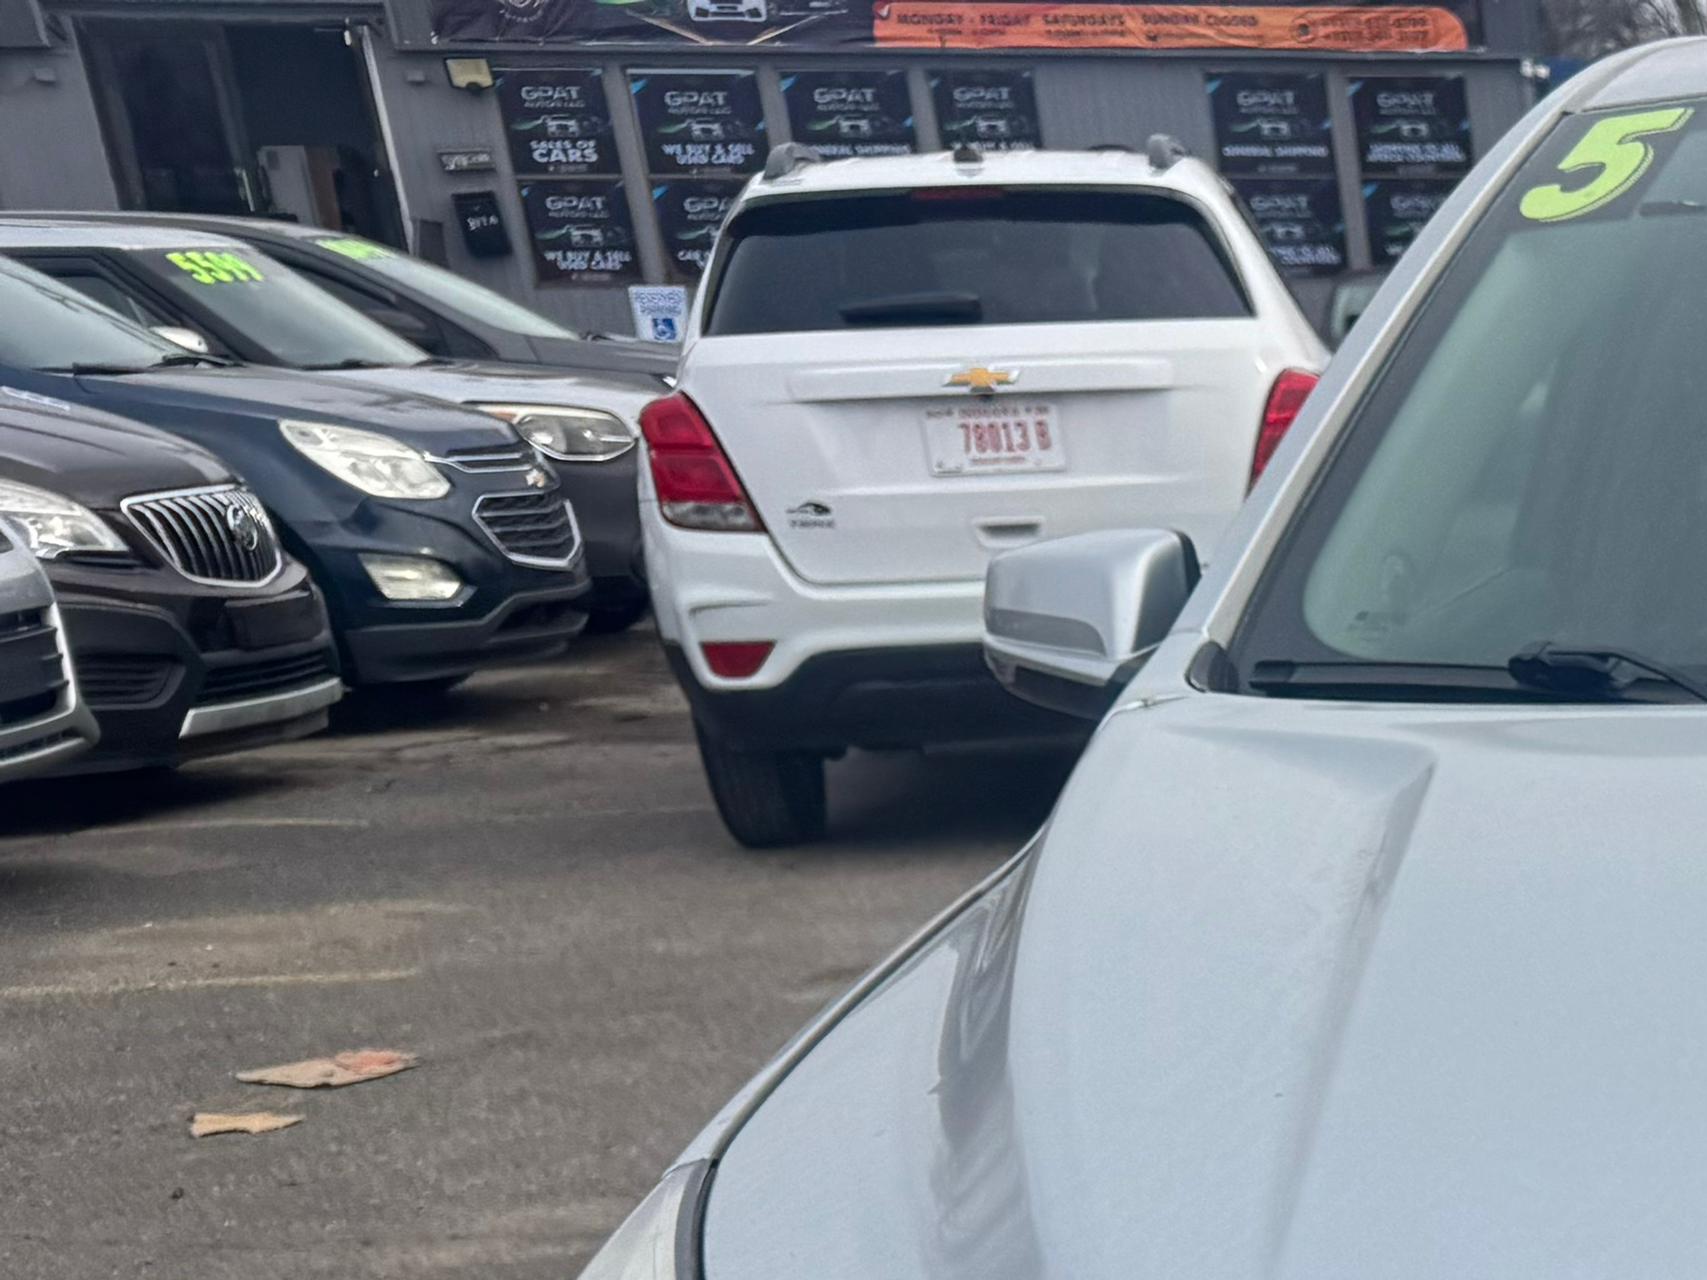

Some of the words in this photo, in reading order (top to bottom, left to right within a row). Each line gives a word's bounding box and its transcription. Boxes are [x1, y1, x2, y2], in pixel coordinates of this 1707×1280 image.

[897, 15, 963, 25] MONDAY
[979, 15, 1031, 25] FRIDAY
[532, 149, 599, 163] CARS
[1519, 106, 1695, 223] 5
